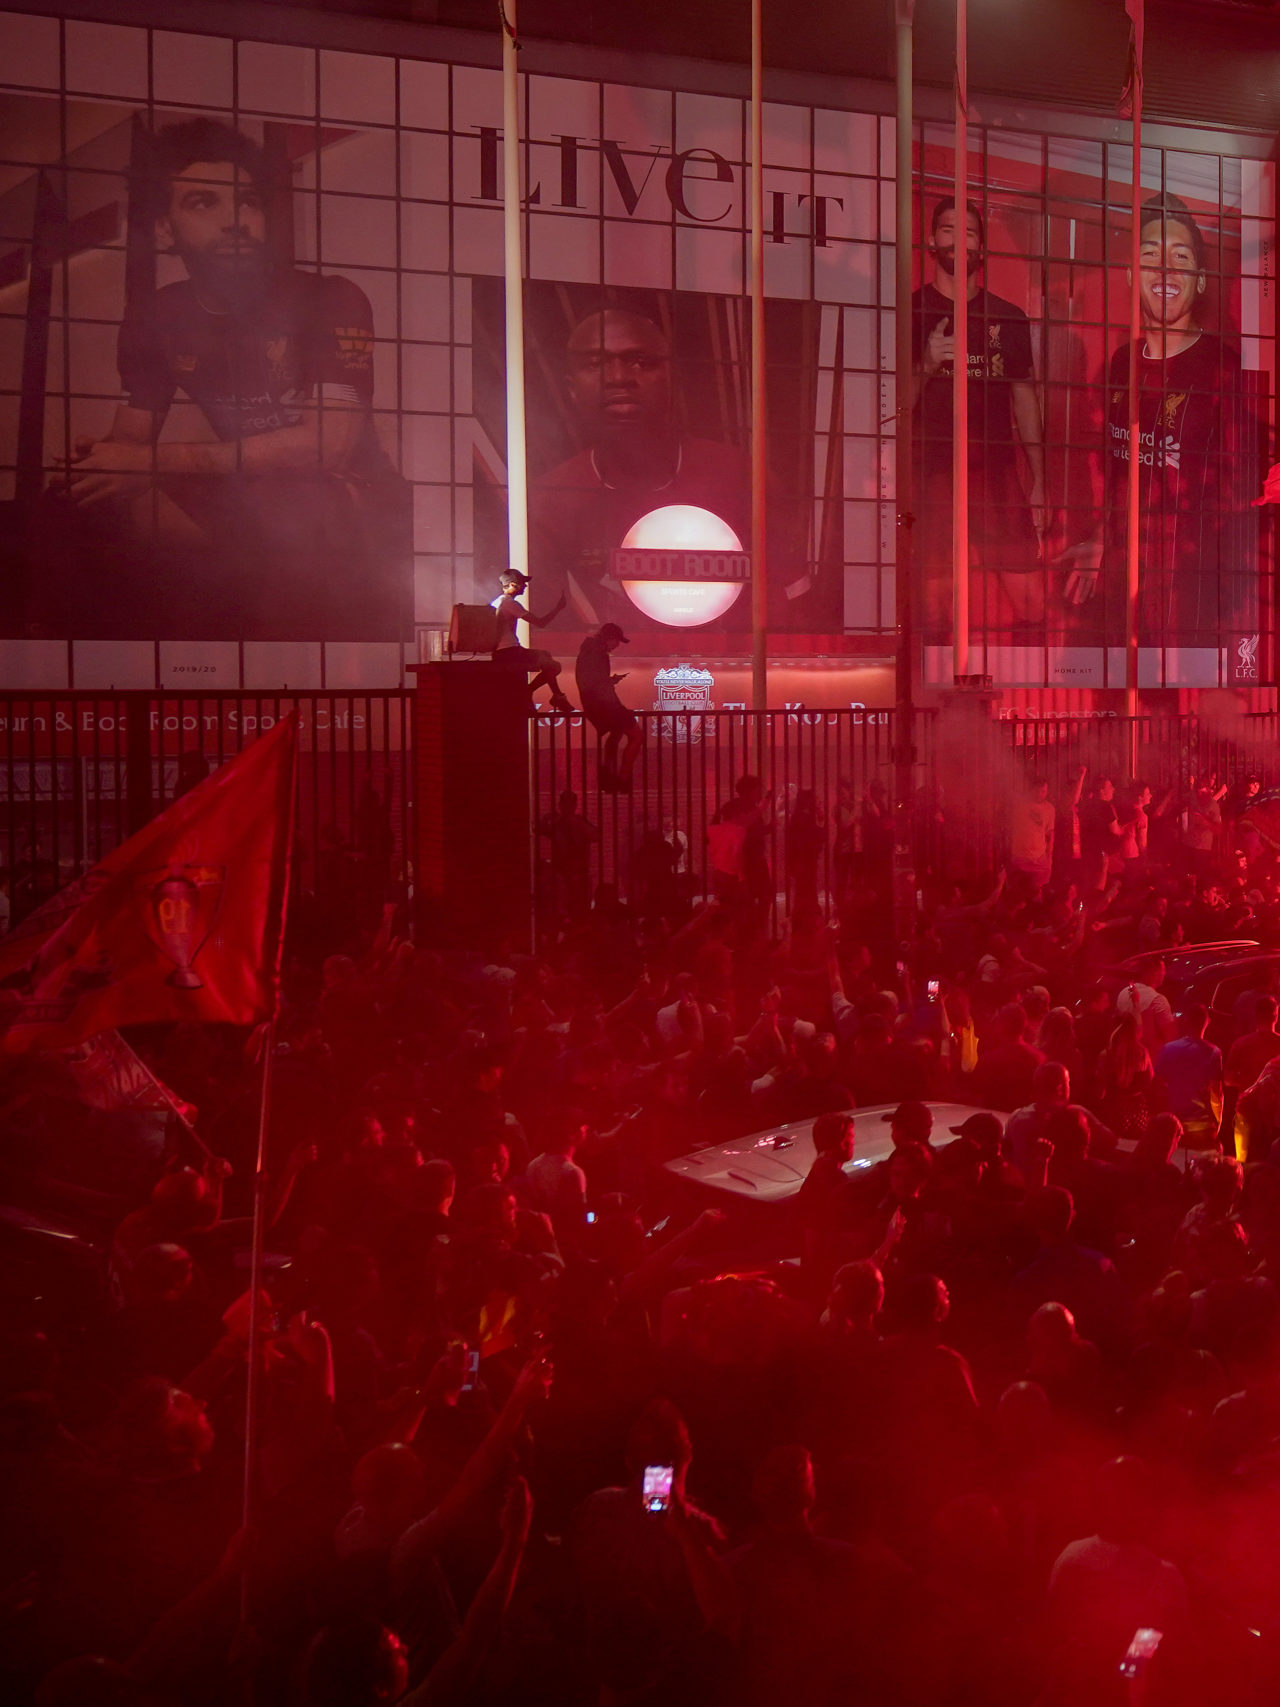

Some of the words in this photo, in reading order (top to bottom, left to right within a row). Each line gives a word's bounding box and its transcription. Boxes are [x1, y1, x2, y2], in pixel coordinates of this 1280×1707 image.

[766, 190, 844, 248] IT
[615, 552, 679, 577] BOOT
[683, 554, 751, 578] ROOM
[1235, 668, 1258, 678] L.F.C.
[663, 692, 704, 700] LIVERPOOL
